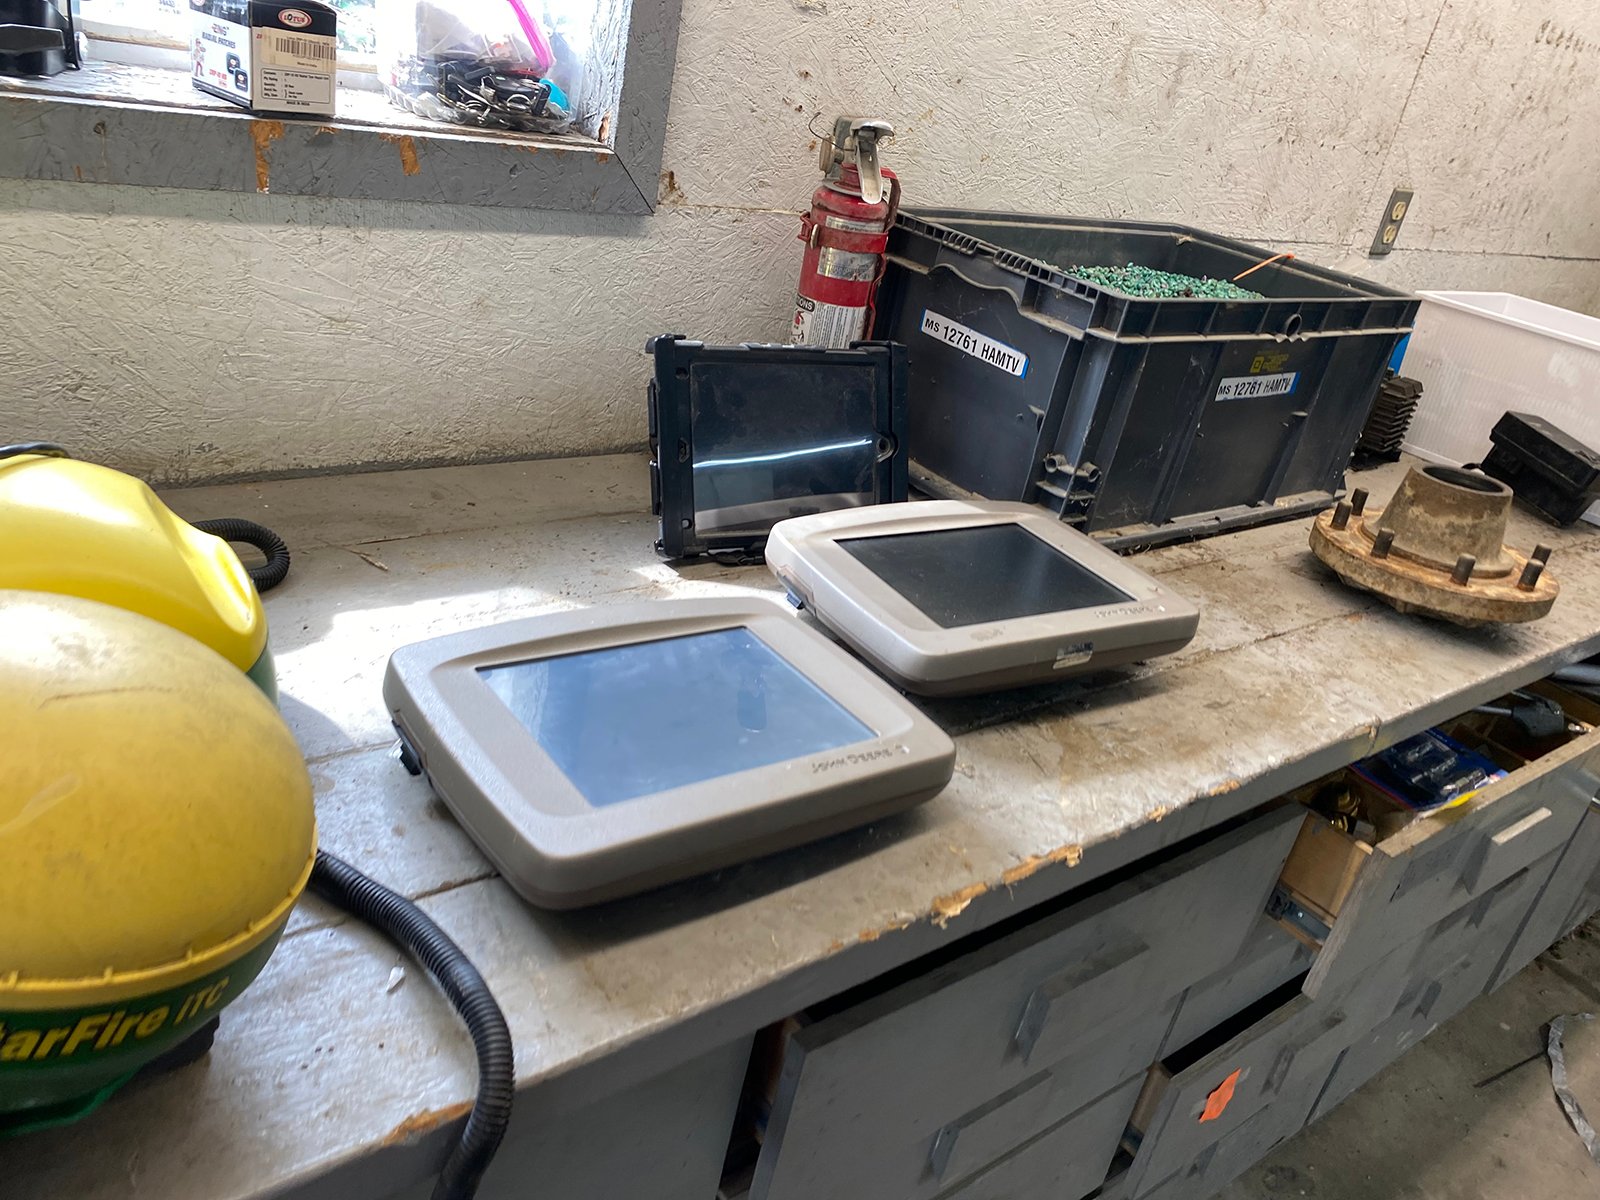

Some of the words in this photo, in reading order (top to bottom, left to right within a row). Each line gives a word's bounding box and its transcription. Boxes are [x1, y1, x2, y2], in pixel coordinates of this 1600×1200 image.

[796, 297, 813, 310] ONS
[924, 318, 940, 333] MS
[942, 325, 978, 353] 12761
[981, 343, 1021, 373] HAMTV
[1217, 385, 1232, 395] MS
[1233, 381, 1263, 396] 12761
[1263, 377, 1291, 393] HAMTV
[0, 1004, 170, 1061] arFire
[174, 976, 230, 1026] ITC
